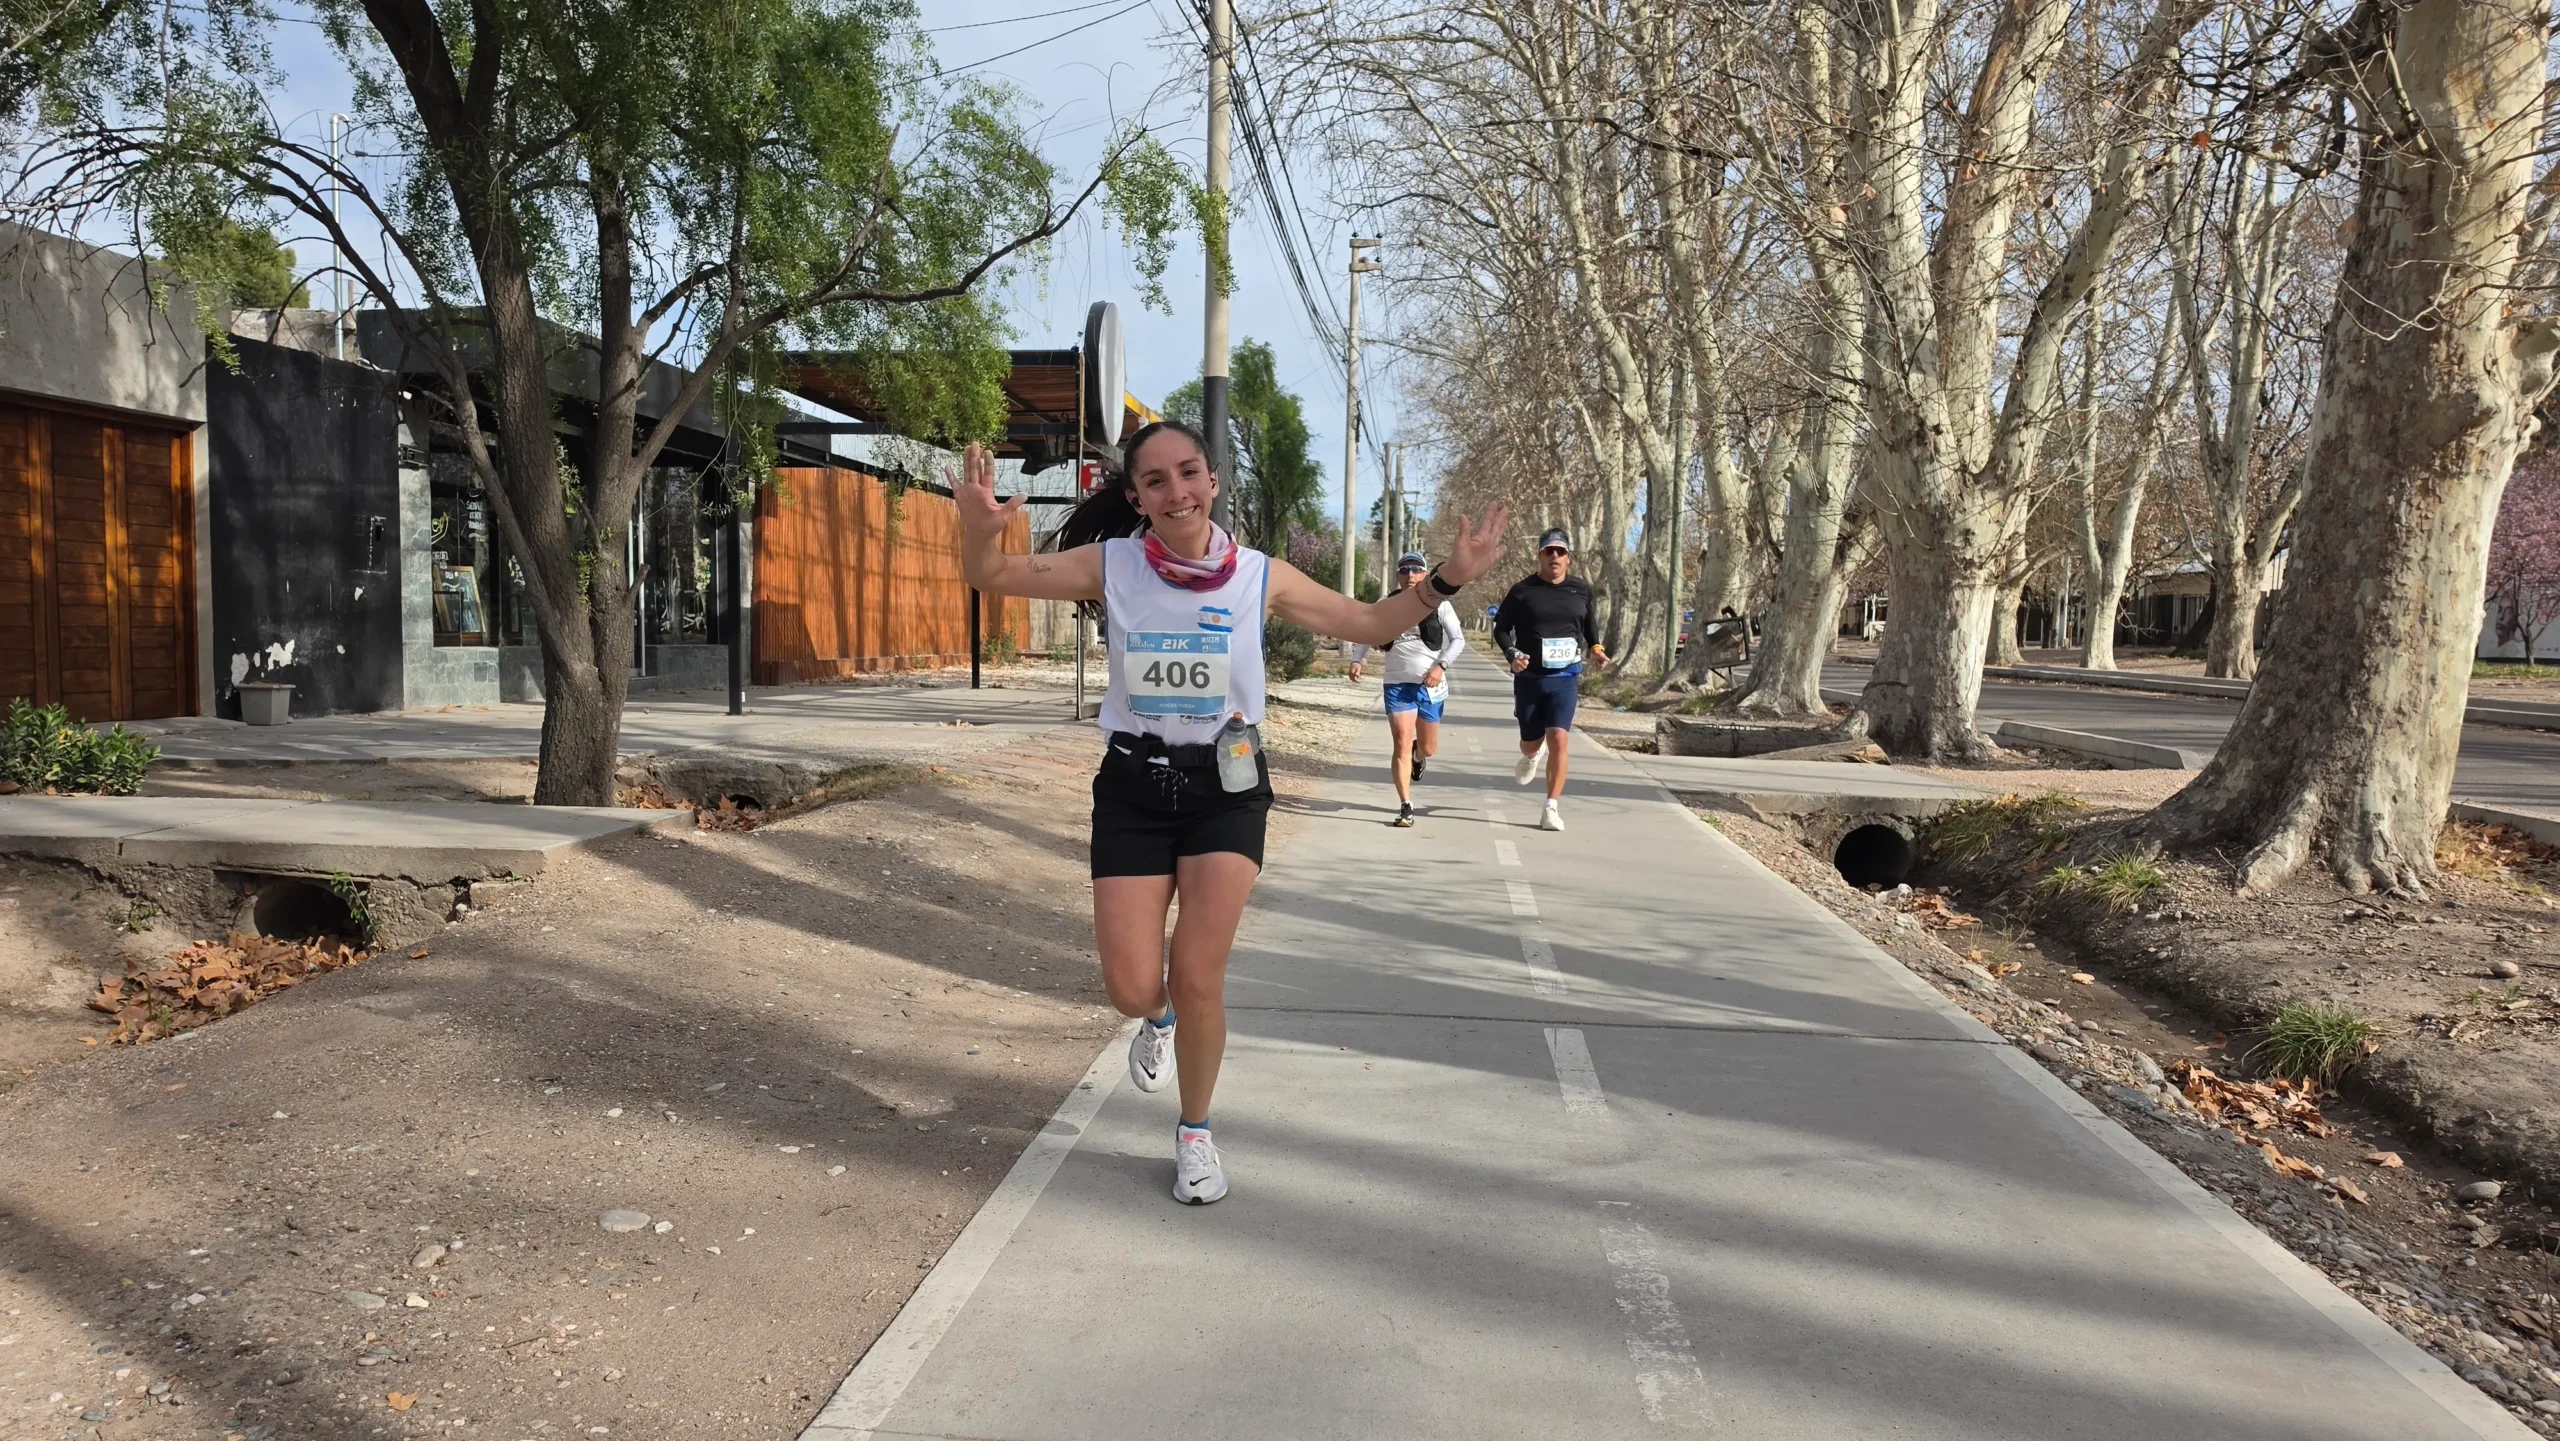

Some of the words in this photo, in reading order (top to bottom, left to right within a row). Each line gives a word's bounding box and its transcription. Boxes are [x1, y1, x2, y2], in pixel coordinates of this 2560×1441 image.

[1161, 638, 1190, 650] 21K
[1549, 648, 1571, 659] 236
[1142, 660, 1211, 690] 406
